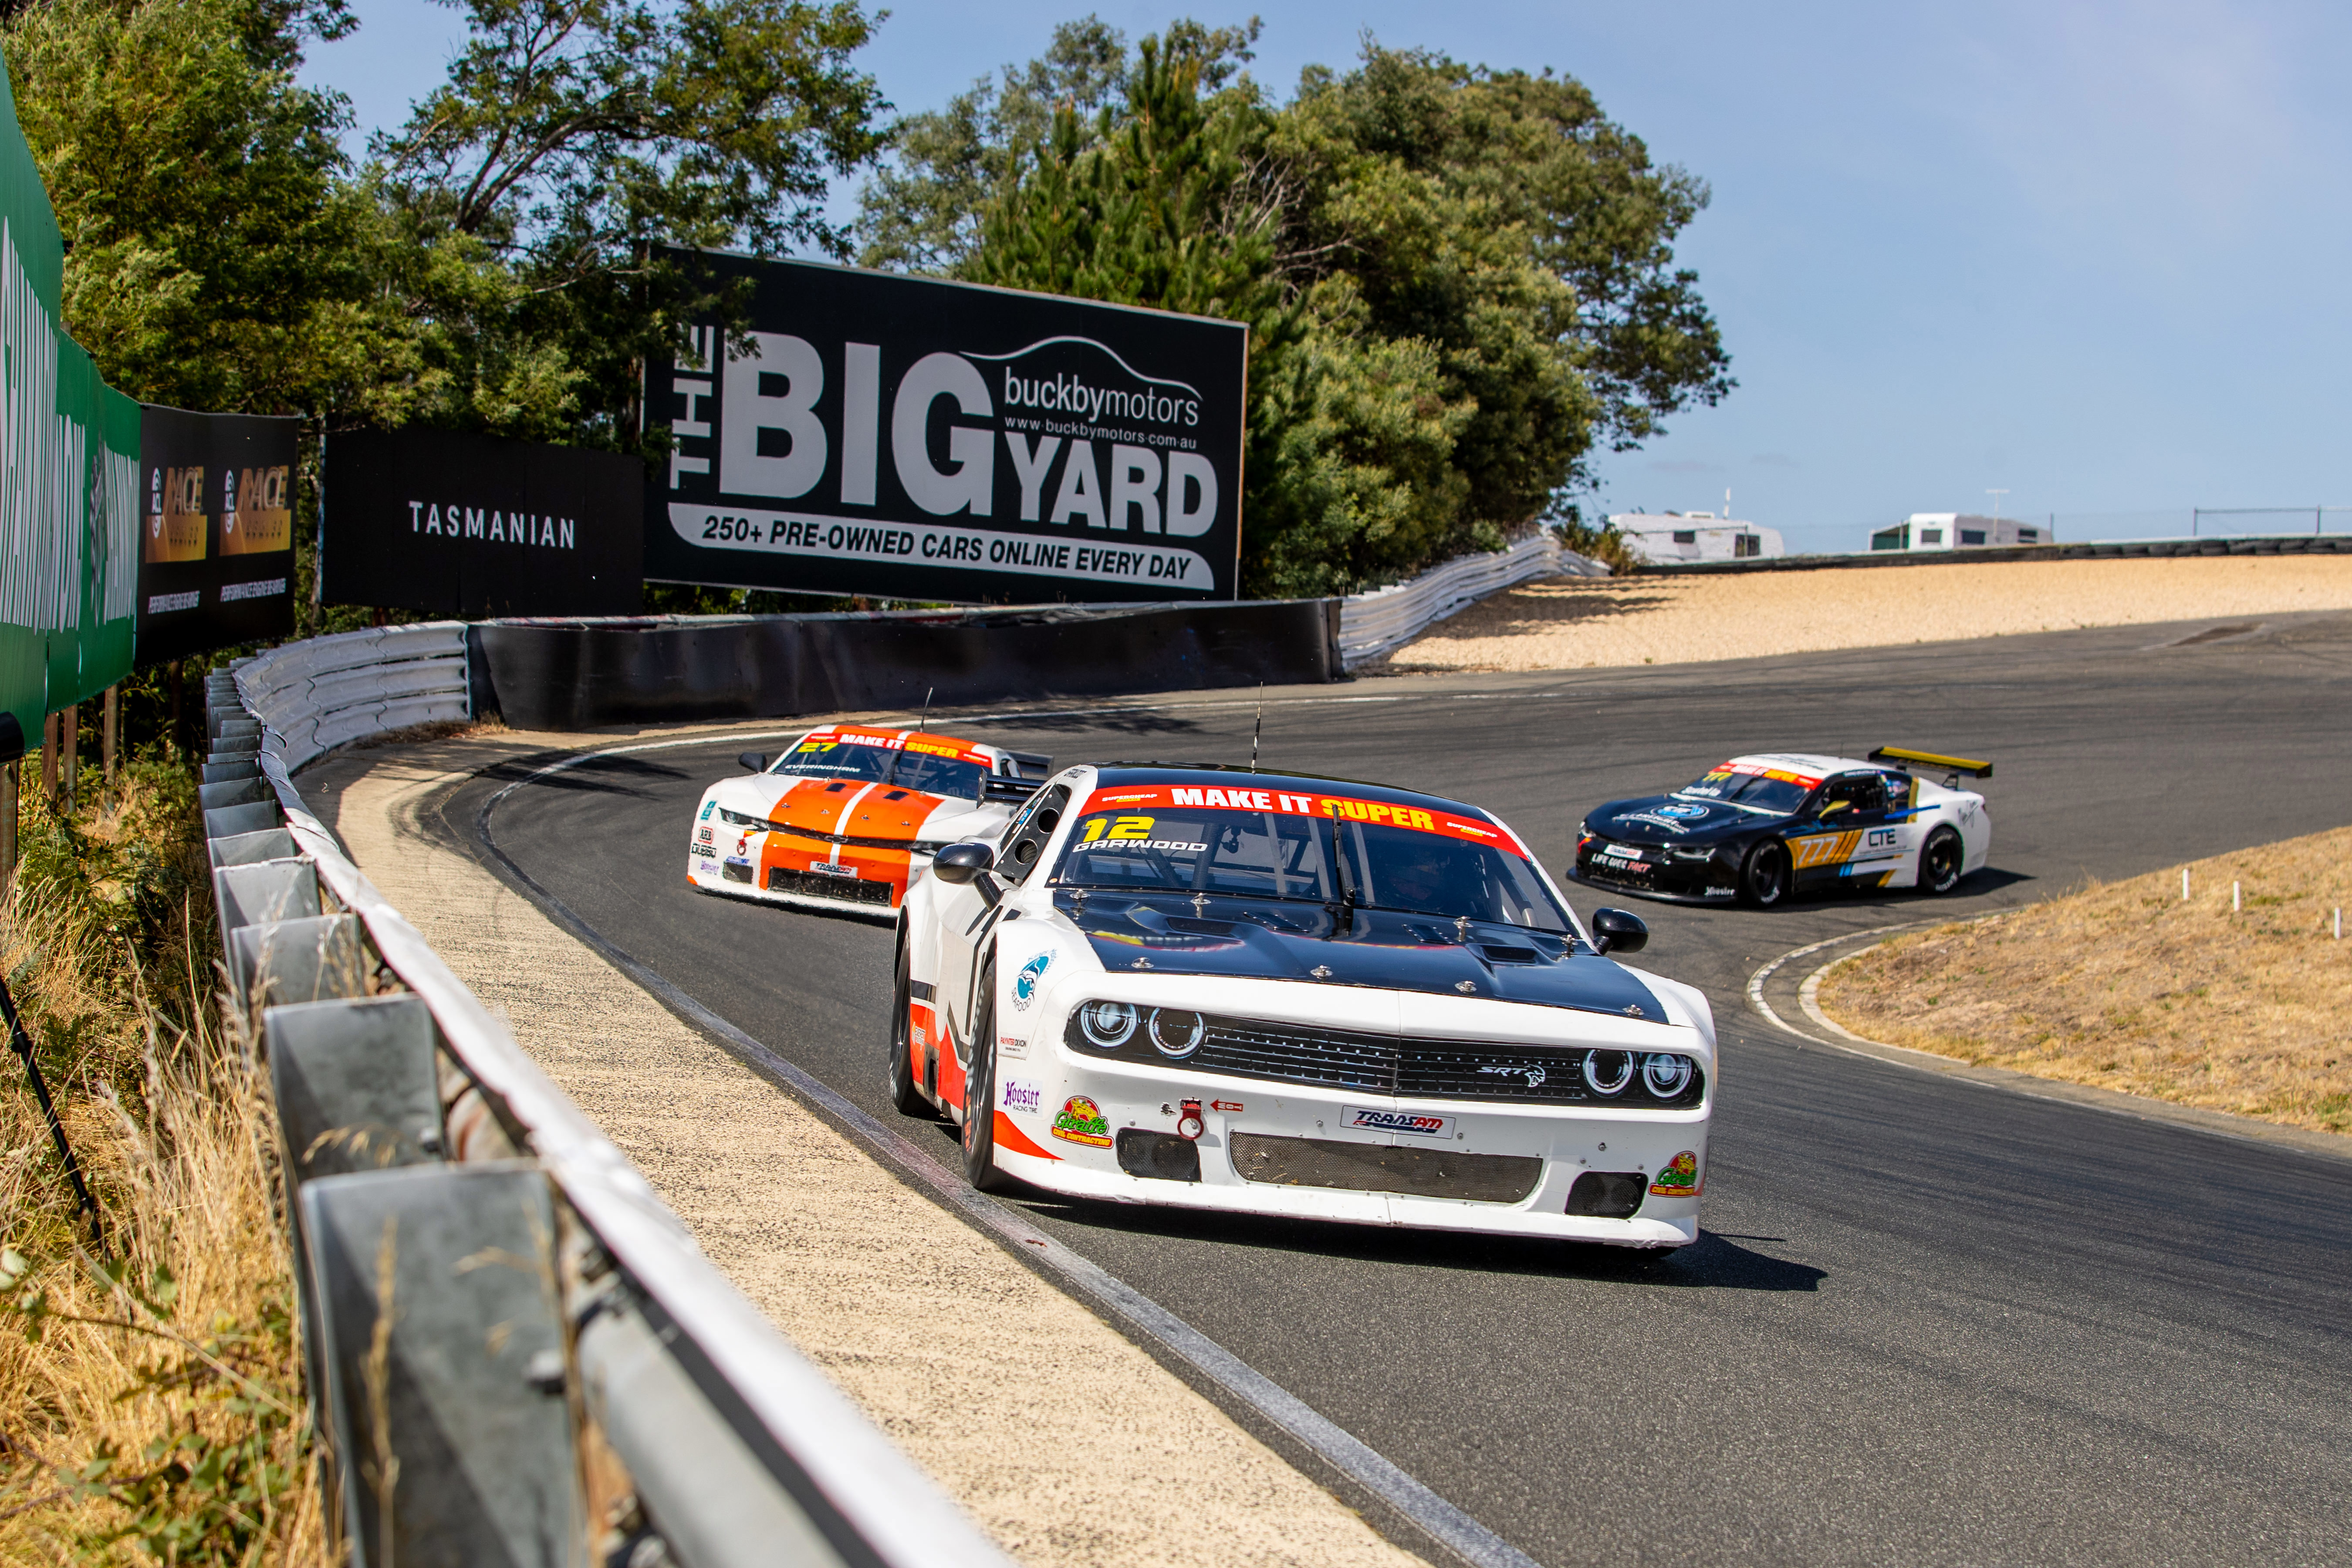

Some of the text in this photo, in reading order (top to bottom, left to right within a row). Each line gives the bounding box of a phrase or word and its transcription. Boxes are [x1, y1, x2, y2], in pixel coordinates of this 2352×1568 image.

[1005, 366, 1199, 426] buckbymotors
[669, 323, 995, 517] THE BIG
[1004, 431, 1219, 538] YARD
[409, 500, 574, 549] TASMANIAN
[702, 515, 1192, 580] 250+ PRE-OWNED CARS ONLINE EVERY DAY
[797, 742, 839, 753] 27
[839, 733, 885, 747] MAKE
[885, 739, 905, 750] IT
[905, 742, 959, 758] SUPER
[785, 764, 861, 773] EVERINGHAM
[1102, 794, 1158, 802] SUPERCHEAP
[1170, 788, 1435, 831] MAKE IT SUPER
[1082, 816, 1155, 842] 12
[1446, 821, 1498, 838] SUPERCHEAP
[1868, 828, 1896, 847] CTE
[1072, 839, 1208, 853] GARWOOD
[1797, 835, 1838, 866] 777
[1592, 852, 1609, 865] LIFE
[1011, 987, 1031, 1011] SEAFOOD
[1476, 1066, 1528, 1077] SRT
[1003, 1080, 1040, 1106] Hoosier
[1217, 1102, 1242, 1111] TOW
[1055, 1111, 1107, 1135] Giraffe
[1053, 1128, 1111, 1146] CIVIL CONTRACTING
